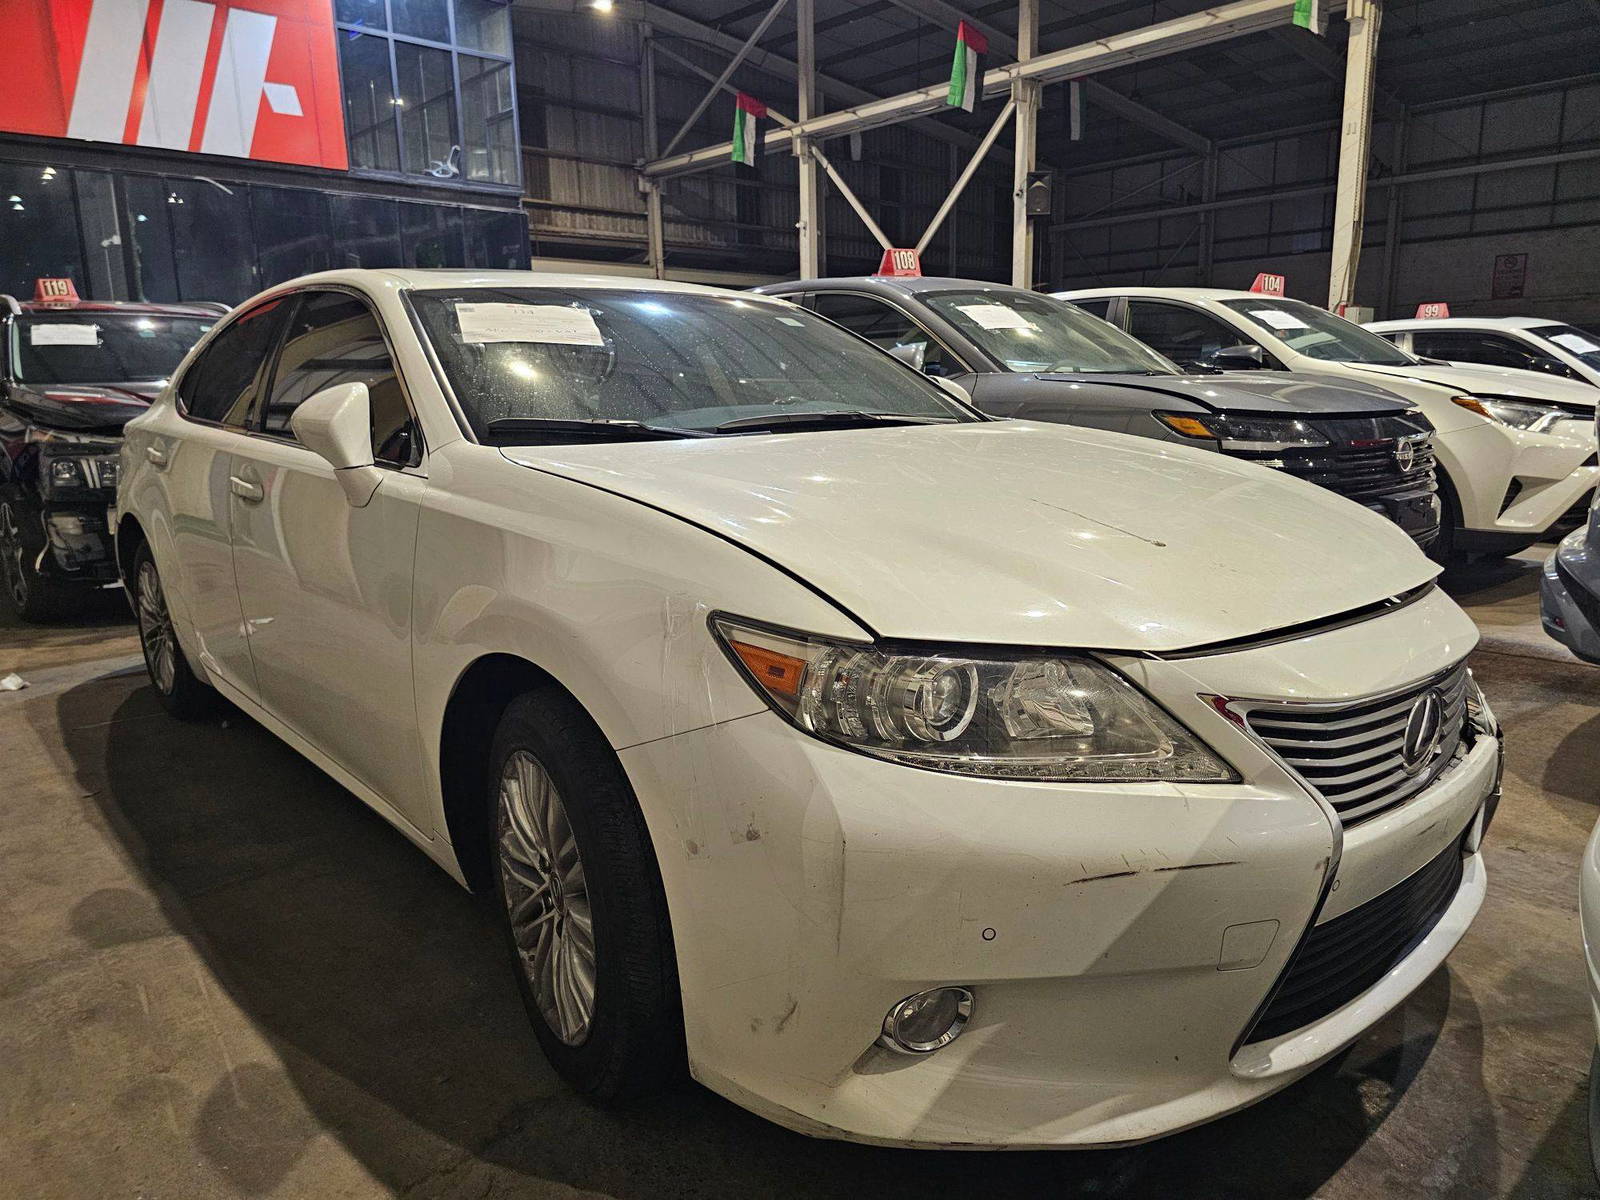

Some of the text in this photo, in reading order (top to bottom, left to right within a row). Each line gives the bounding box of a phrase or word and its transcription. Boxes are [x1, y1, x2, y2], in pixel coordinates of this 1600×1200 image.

[894, 251, 915, 270] 108
[44, 280, 69, 296] 119
[1264, 276, 1281, 292] 104
[1424, 305, 1439, 318] 99
